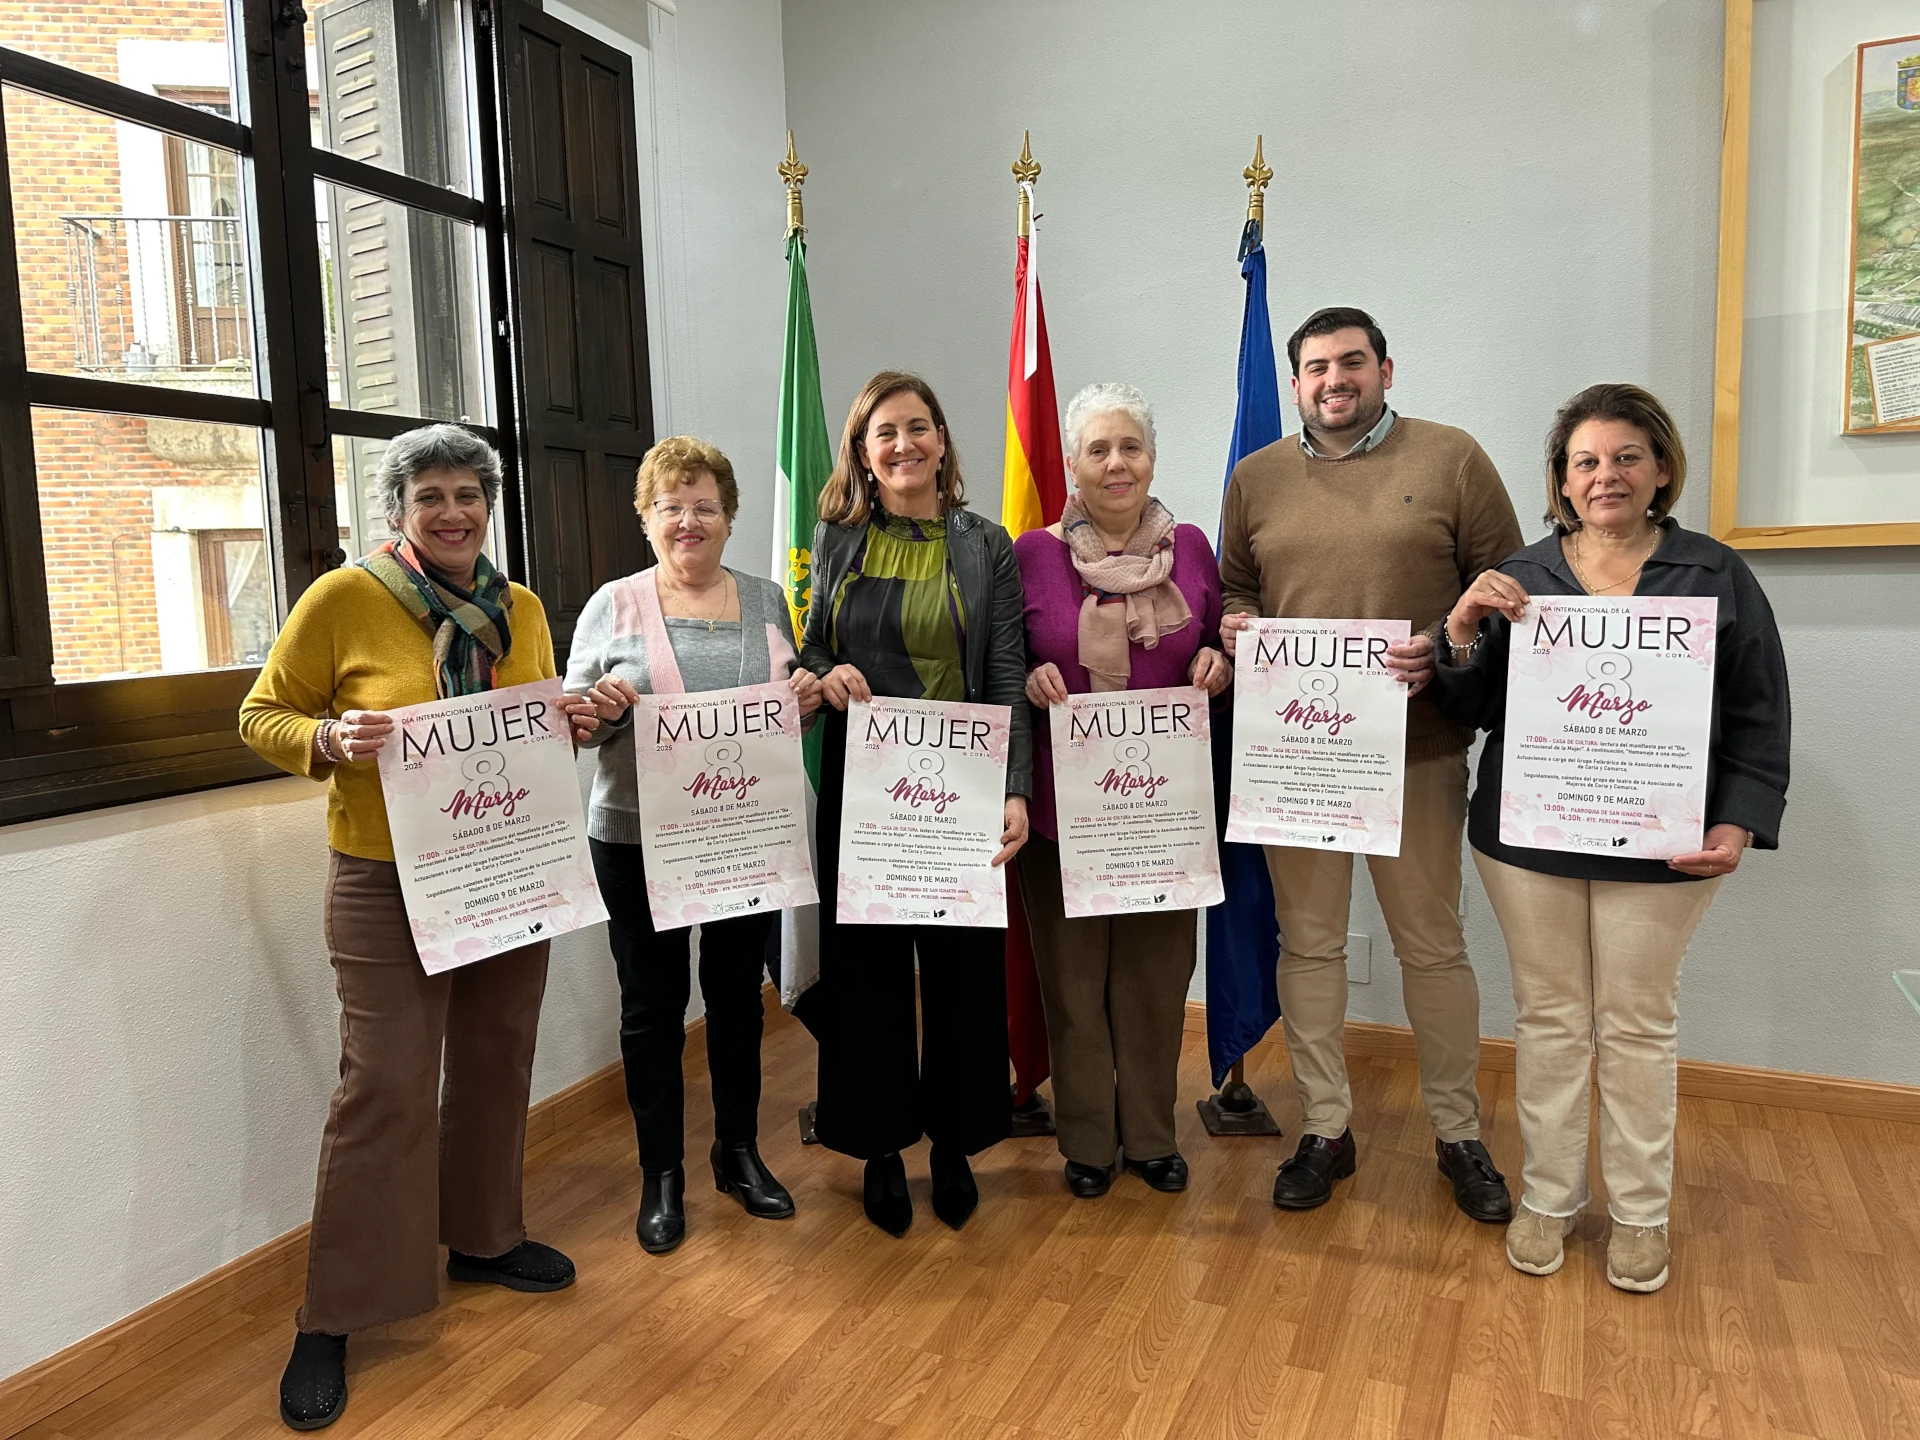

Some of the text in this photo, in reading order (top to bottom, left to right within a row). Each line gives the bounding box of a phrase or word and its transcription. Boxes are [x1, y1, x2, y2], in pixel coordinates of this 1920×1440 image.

[1534, 615, 1690, 650] MUJER
[1255, 637, 1388, 668] MUJER
[1532, 647, 1550, 655] 2025
[1585, 652, 1633, 708] 8
[1298, 670, 1339, 721] 8
[1558, 685, 1651, 724] Marzo
[671, 701, 719, 711] INTERNACIONAL
[1083, 701, 1127, 709] INTERNACIONAL
[402, 716, 415, 725] DÍA
[416, 707, 473, 722] INTERNACIONAL
[657, 700, 782, 743] MUJER
[1071, 704, 1190, 740] MUJER
[1276, 700, 1355, 735] Marzo
[403, 701, 548, 762] MUJER
[531, 734, 553, 743] CORIA
[867, 715, 990, 750] MUJER
[1564, 723, 1596, 734] SÁBADO
[1606, 727, 1616, 735] DE
[1619, 728, 1647, 736] MARZO
[656, 744, 672, 752] 2025
[1282, 734, 1309, 743] SÁBADO
[1328, 738, 1352, 746] MARZO
[1526, 735, 1547, 743] 17:00h
[404, 761, 423, 771] 2025
[705, 740, 744, 789] 8
[1114, 739, 1152, 787] 8
[462, 750, 510, 807] 8
[907, 750, 945, 799] 8
[1095, 767, 1168, 798] Marzo
[684, 770, 759, 800] Marzo
[441, 785, 529, 819] Marzo
[885, 778, 960, 813] Marzo
[1277, 796, 1308, 805] DOMINGO
[1327, 800, 1351, 808] MARZO
[1558, 792, 1594, 802] DOMINGO
[1604, 796, 1614, 804] DE
[1617, 796, 1645, 806] MARZO
[691, 806, 718, 816] SÁBADO
[736, 800, 758, 809] MARZO
[1103, 803, 1128, 811] SÁBADO
[1146, 800, 1168, 808] MARZO
[1544, 804, 1565, 812] 13:00h
[660, 823, 679, 831] 17:00h
[890, 812, 916, 821] SÁBADO
[934, 816, 957, 824] MARZO
[453, 826, 484, 841] SÁBADO
[493, 821, 503, 830] DE
[504, 815, 530, 827] MARZO
[418, 851, 440, 862] 17:00h
[1106, 861, 1135, 870] DOMINGO
[695, 866, 725, 878] DOMINGO
[743, 860, 765, 870] MARZO
[886, 874, 916, 882] DOMINGO
[464, 880, 545, 910] DOMINGO 9 DE MARZO
[685, 882, 704, 891] 13:00h
[454, 914, 476, 925] 13:00h
[481, 906, 508, 918] PARROQUIA
[508, 933, 526, 942] CORIA
